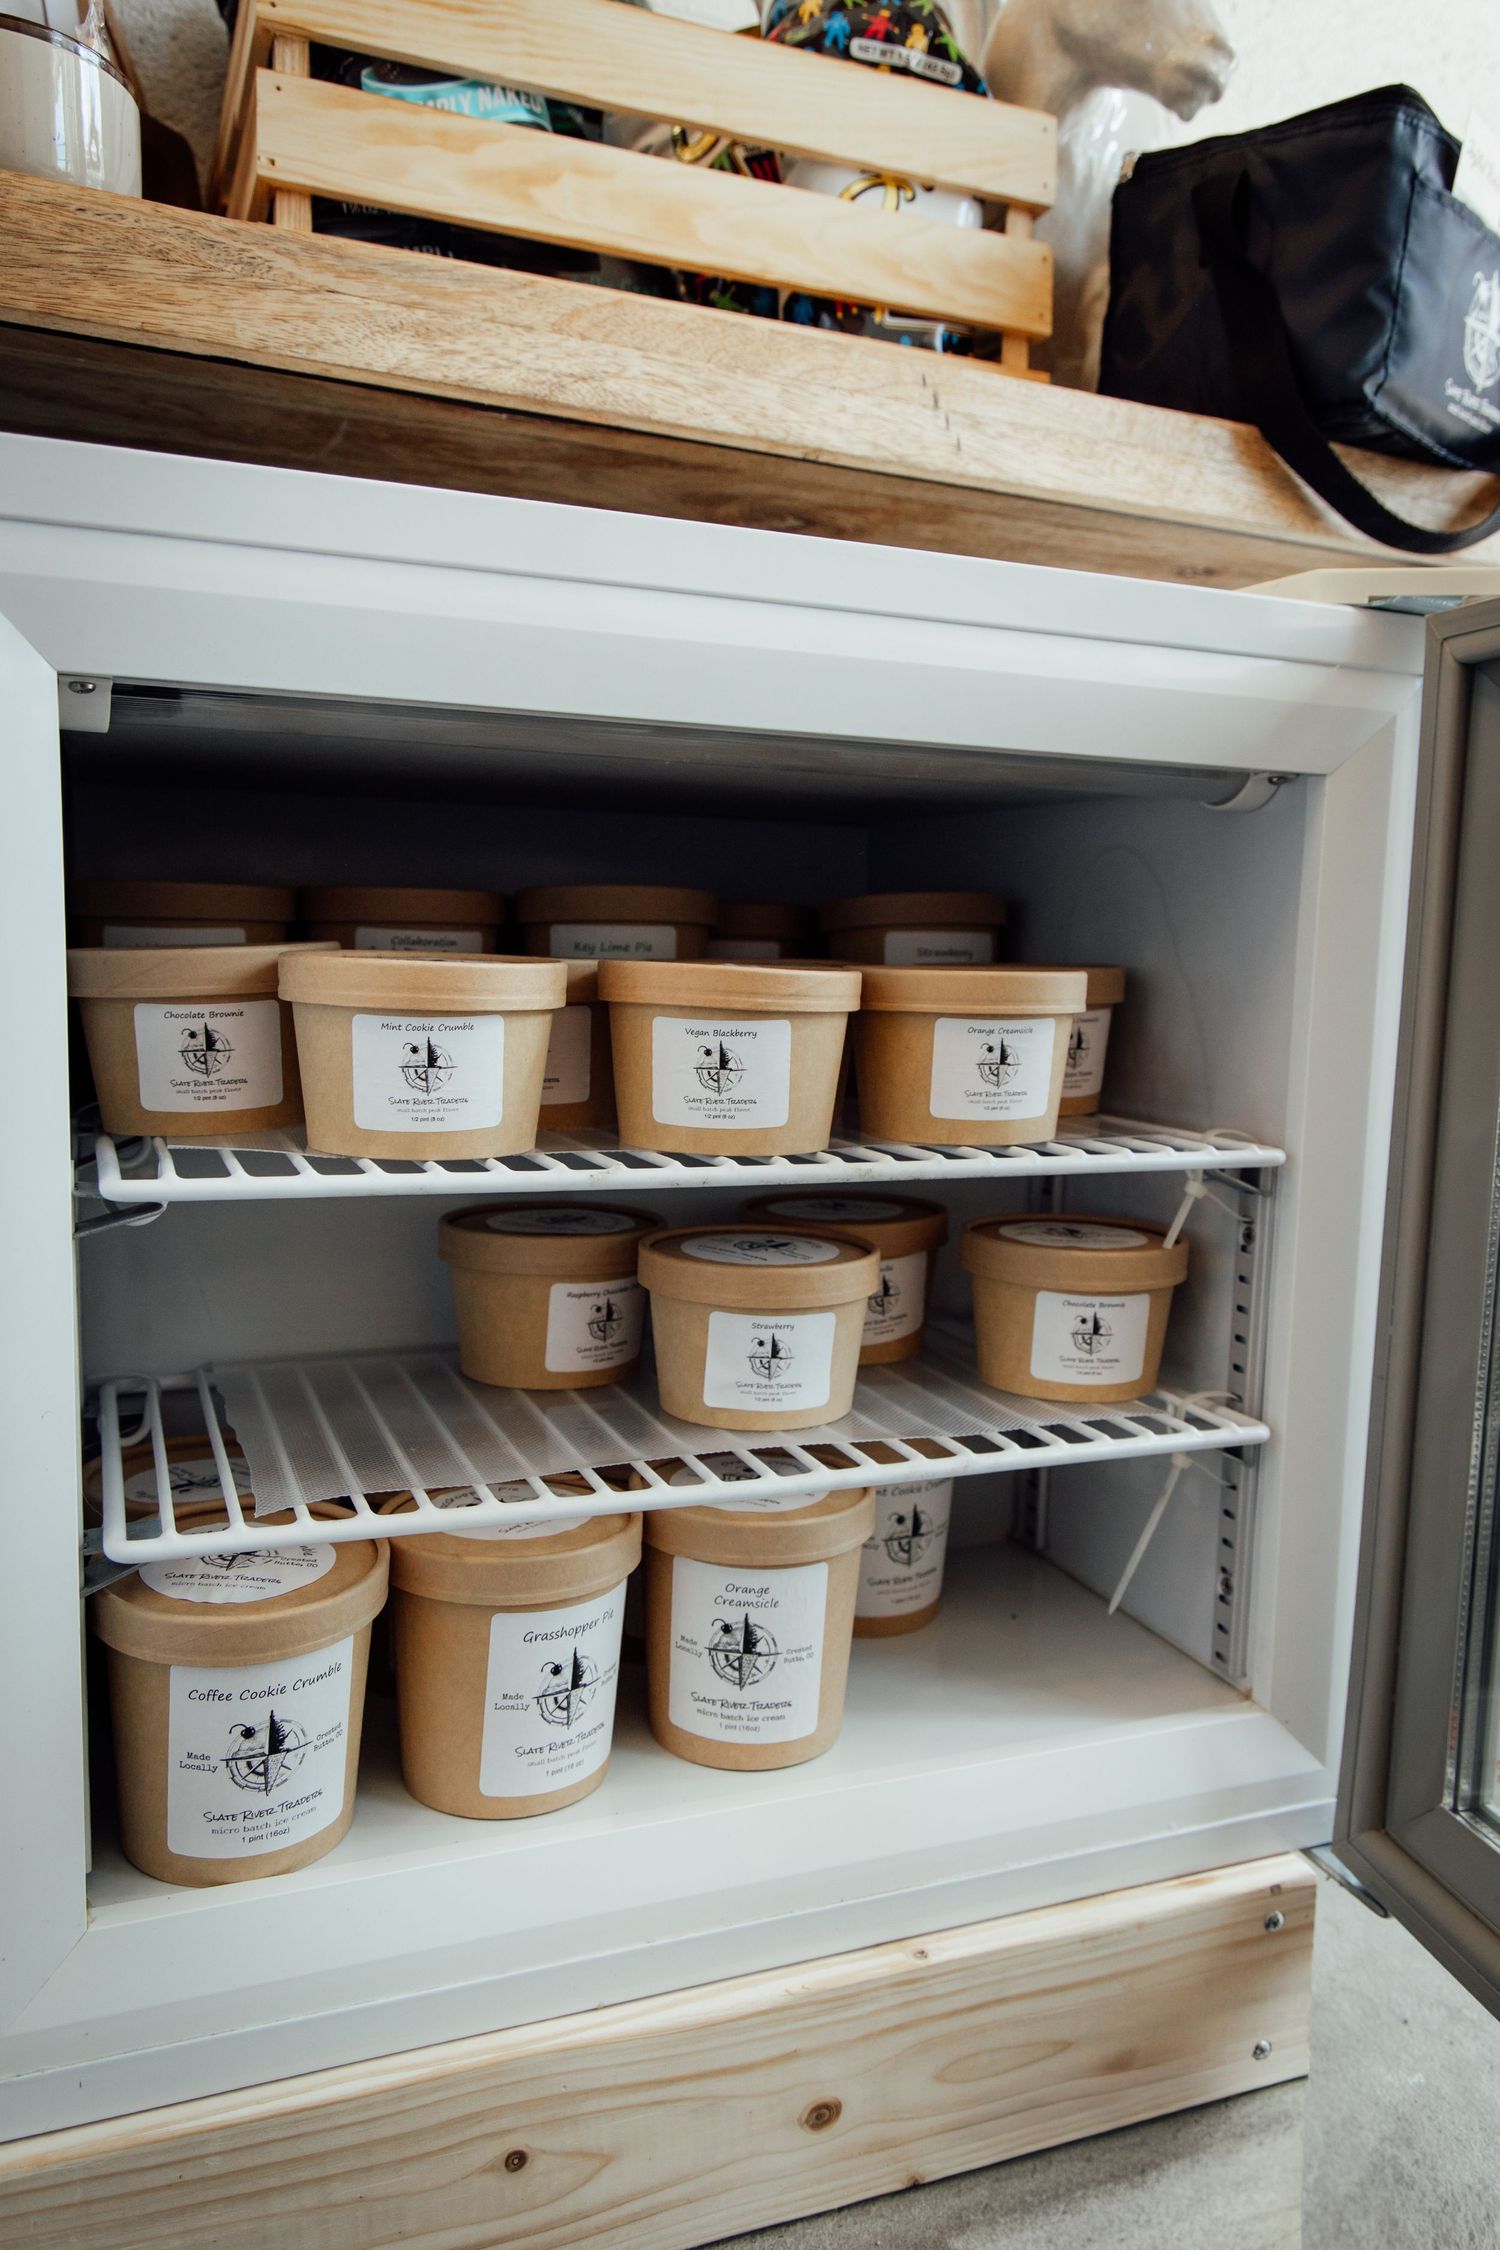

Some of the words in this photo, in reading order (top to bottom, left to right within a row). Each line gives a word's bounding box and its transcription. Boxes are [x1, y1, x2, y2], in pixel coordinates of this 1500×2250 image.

[573, 941, 595, 955] Key
[600, 940, 630, 953] Lime
[635, 941, 654, 953] Pie
[164, 1011, 206, 1019] Chocolate
[209, 1008, 244, 1019] Brownie
[380, 1022, 402, 1031] Mint
[405, 1023, 434, 1032] Cookie
[438, 1022, 474, 1032] Crumble
[685, 1028, 710, 1038] Vegan
[713, 1028, 758, 1039] Blackberry
[967, 1026, 995, 1035] Orange
[1062, 1299, 1096, 1308] Chocolate
[751, 1322, 795, 1331] Strawberry
[725, 1582, 770, 1599] Orange
[714, 1595, 780, 1609] Creamsicle
[523, 1615, 601, 1644] Grasshopper
[602, 1607, 615, 1625] Pie
[680, 1634, 698, 1646] Made
[675, 1641, 703, 1659] Locally
[188, 1688, 233, 1702] Coffee
[239, 1683, 287, 1702] Cookie
[292, 1661, 342, 1692] Crumble
[502, 1692, 525, 1701] Made
[690, 1691, 717, 1707] SLATE
[720, 1698, 750, 1710] RIVER
[750, 1700, 793, 1711] TRADERS
[494, 1701, 531, 1713] Locally
[696, 1708, 718, 1719] micro
[720, 1712, 744, 1722] batch
[746, 1714, 760, 1722] ice
[761, 1714, 786, 1722] cream
[316, 1721, 342, 1742] Crested
[514, 1744, 545, 1758] SLATE
[547, 1739, 575, 1754] RIVER
[186, 1751, 211, 1762] Made
[179, 1760, 218, 1774] Locally
[551, 1765, 564, 1778] pint
[203, 1811, 238, 1824] SLATE
[240, 1806, 280, 1823] RIVER
[279, 1788, 324, 1814] TRADERS
[211, 1825, 240, 1835] micro
[242, 1821, 272, 1834] batch
[274, 1817, 289, 1828] ice
[291, 1805, 317, 1822] cream
[248, 1831, 264, 1844] pint
[265, 1826, 291, 1841] (16oz)
